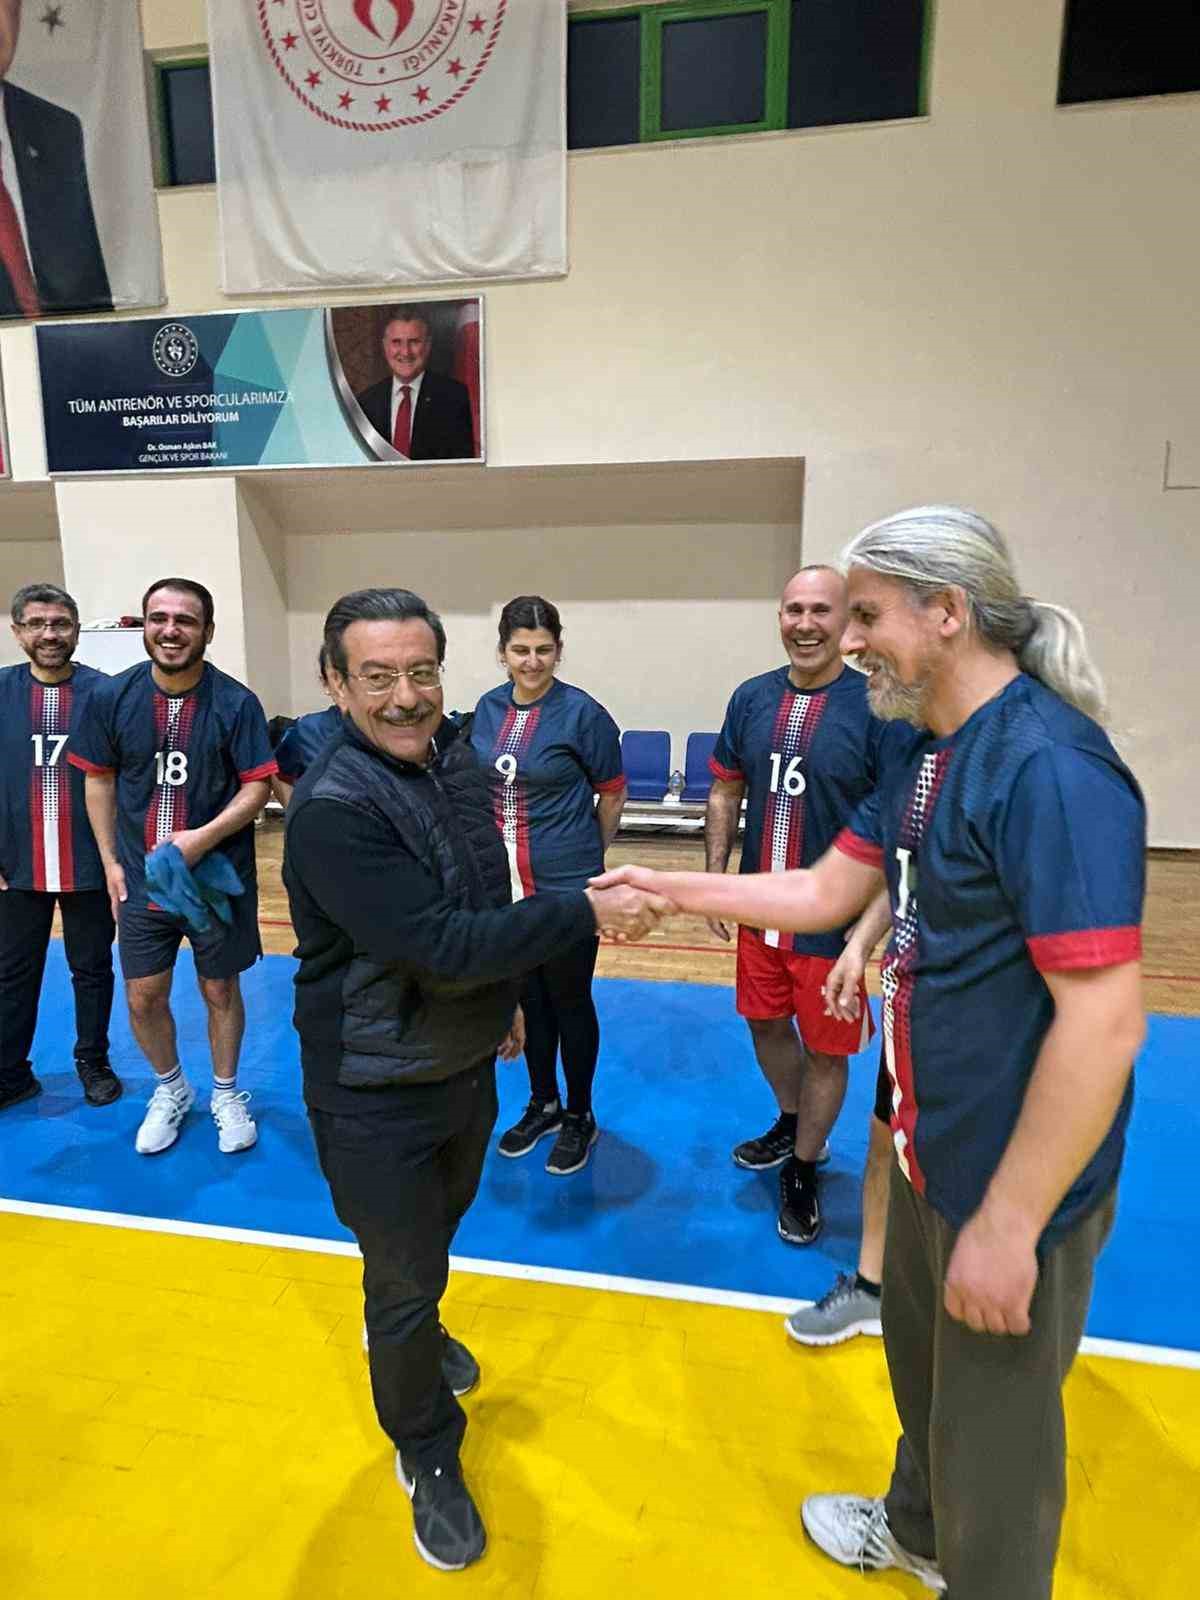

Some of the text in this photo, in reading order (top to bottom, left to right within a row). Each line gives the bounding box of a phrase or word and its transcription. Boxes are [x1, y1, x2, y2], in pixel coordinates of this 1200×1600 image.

[67, 390, 295, 414] TÜM ANTRENÖR VE SPORCULARIMIZA
[122, 411, 240, 429] BAŞARILAR DİLİYORUM
[180, 452, 200, 462] SPOR
[30, 733, 70, 767] 17
[154, 750, 189, 786] 18
[494, 753, 518, 787] 9
[768, 751, 807, 796] 16
